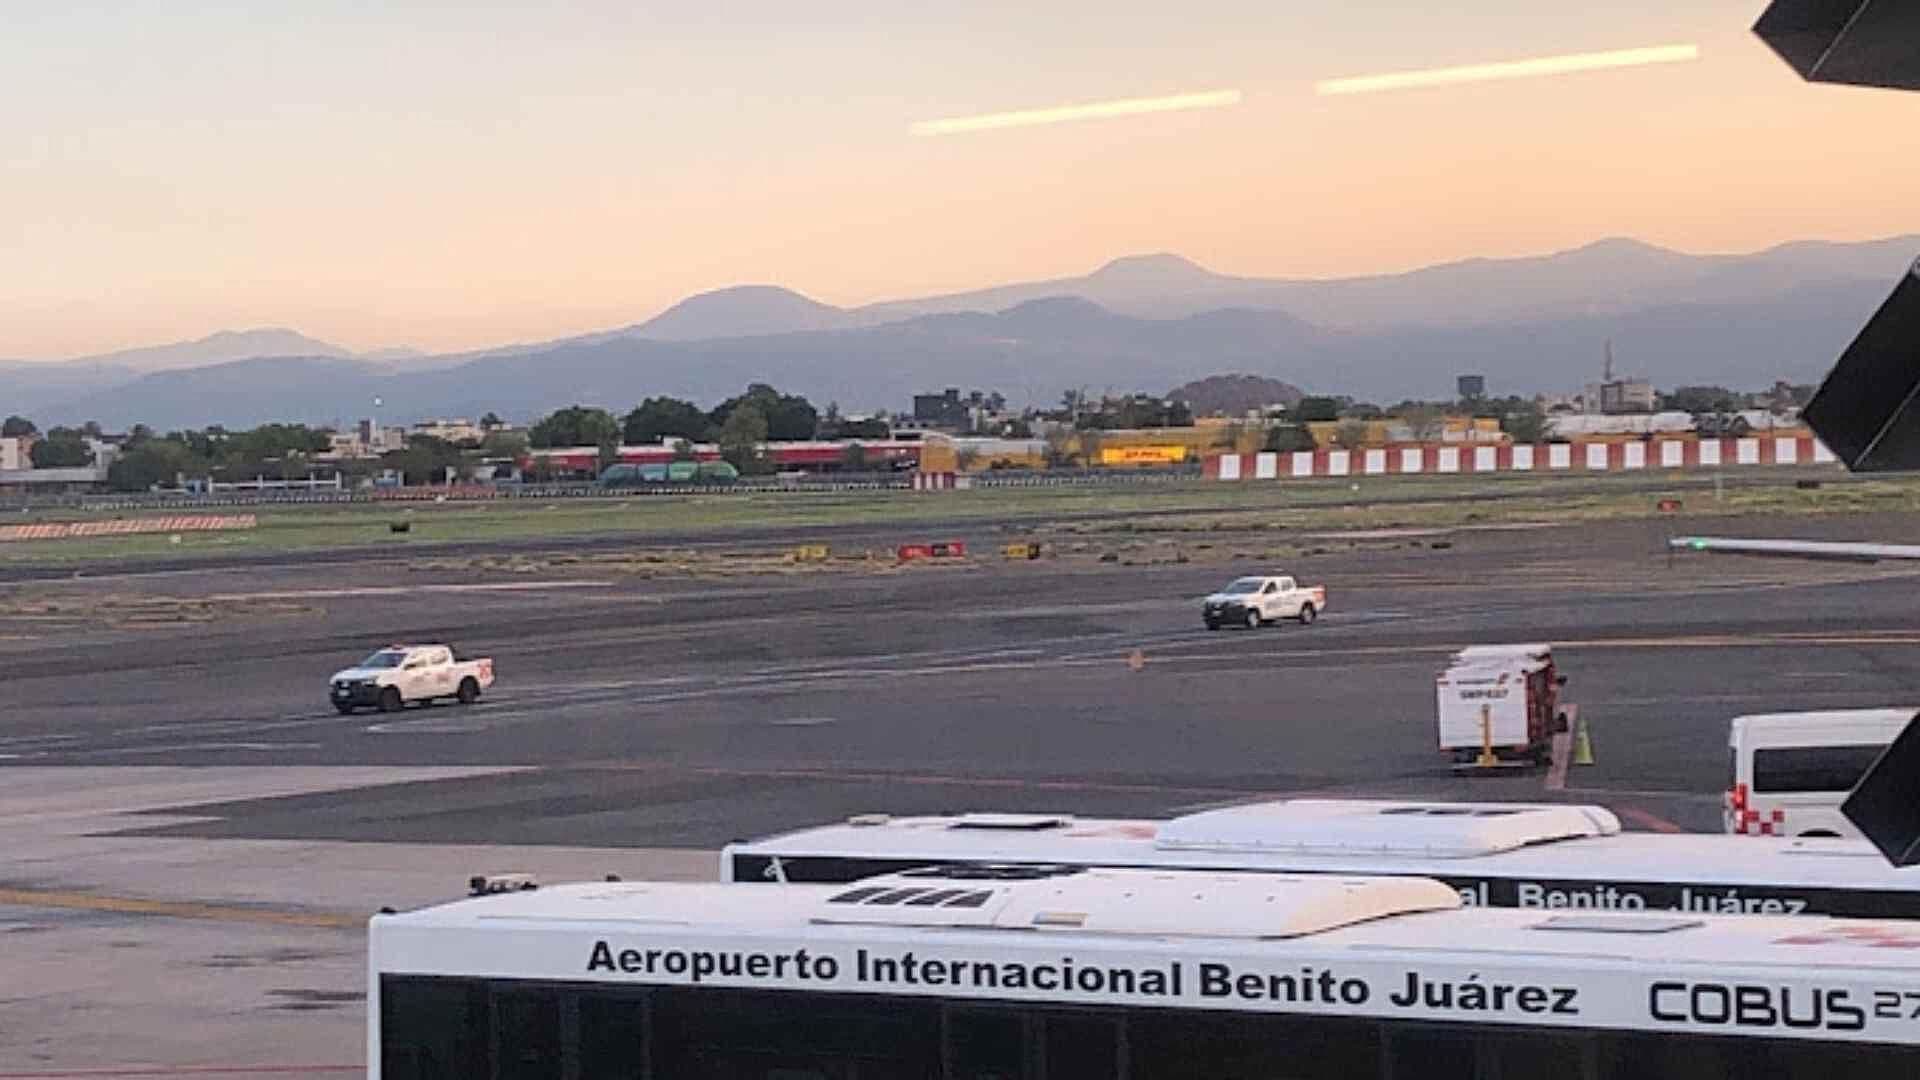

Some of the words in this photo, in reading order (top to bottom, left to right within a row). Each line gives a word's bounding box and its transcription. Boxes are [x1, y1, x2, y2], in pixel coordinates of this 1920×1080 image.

[1518, 883, 1646, 912] Benito
[586, 940, 840, 982] Aeropuerto
[856, 949, 1181, 996] Internacional
[1200, 963, 1370, 1005] Benito
[1389, 972, 1579, 1015] Juárez
[1650, 981, 1866, 1031] COBUS
